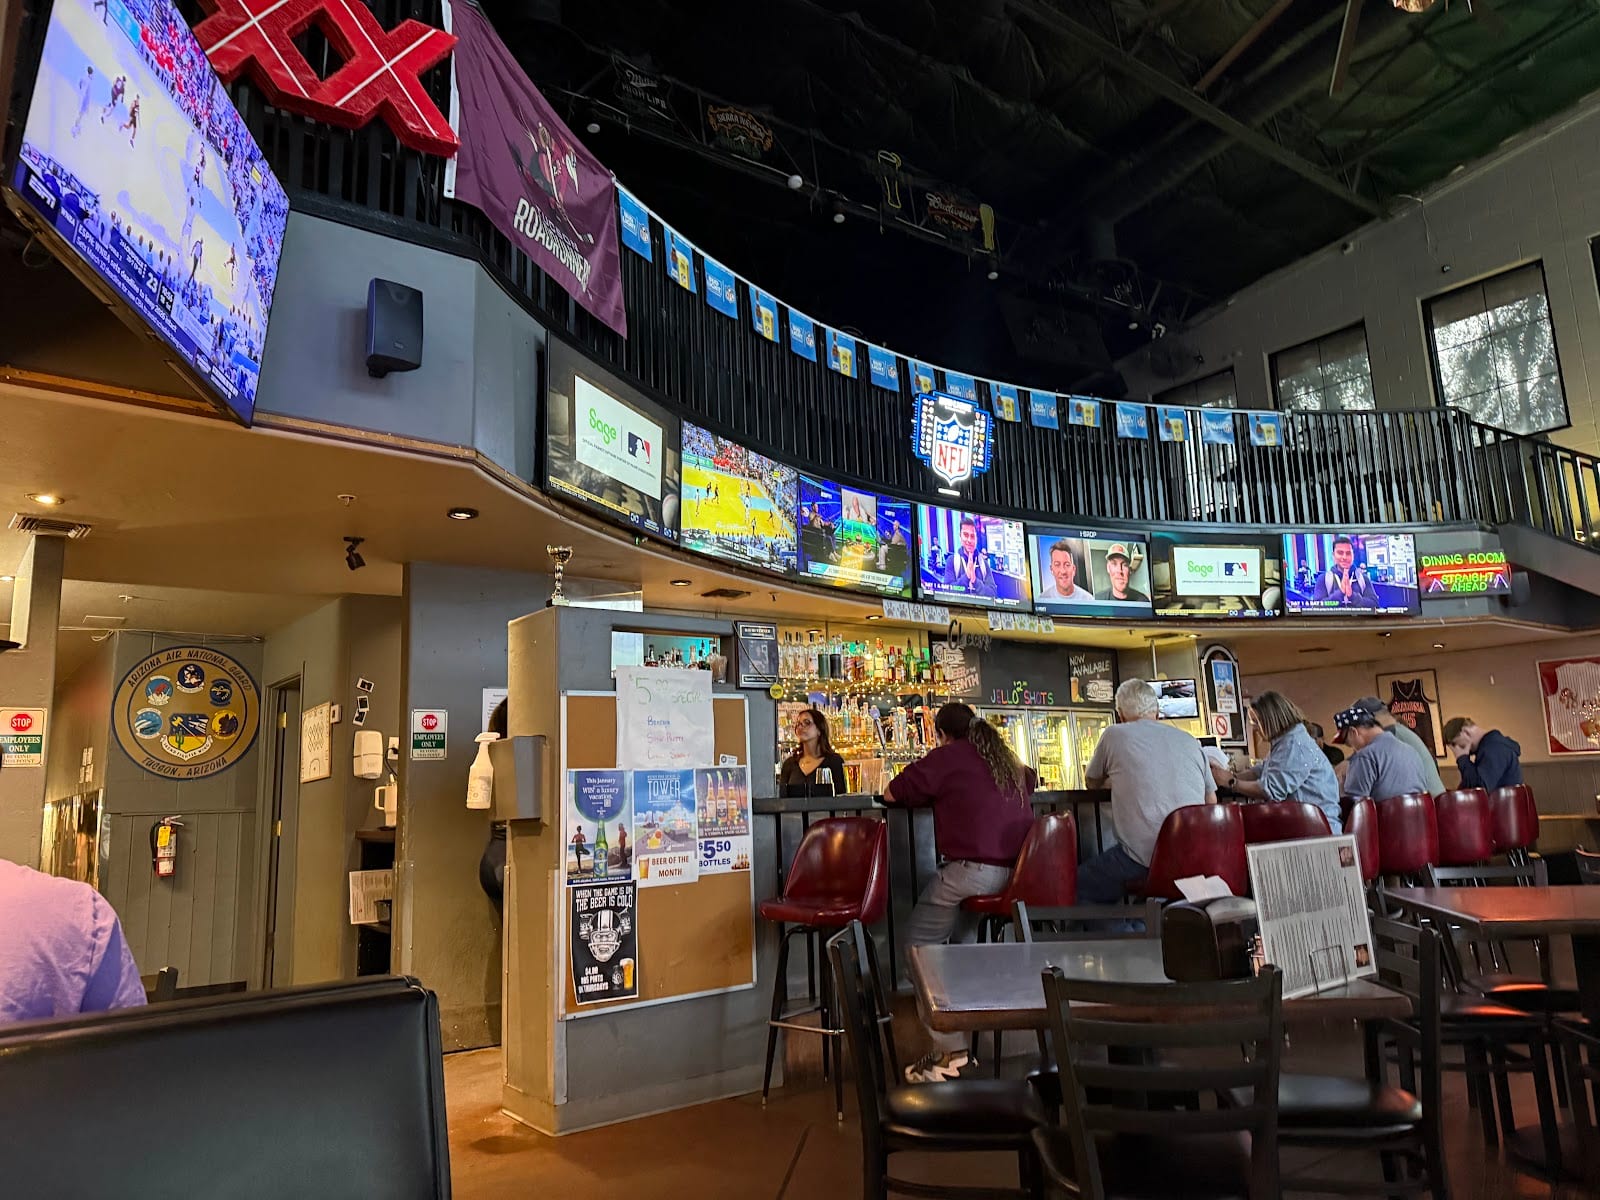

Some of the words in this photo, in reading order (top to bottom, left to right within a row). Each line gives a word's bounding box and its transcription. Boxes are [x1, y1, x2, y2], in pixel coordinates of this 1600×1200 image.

[589, 407, 617, 445] Sage
[938, 443, 965, 474] NFL
[1422, 553, 1464, 567] DINING
[1468, 552, 1505, 564] ROOM
[1187, 560, 1214, 577] Sage
[1441, 572, 1494, 584] STRAIGHT
[1451, 582, 1488, 592] AHEAD
[1070, 653, 1085, 666] NOW
[127, 657, 162, 688] ARIZONA
[166, 650, 182, 661] AIR
[187, 650, 227, 667] NATIONAL
[228, 666, 252, 691] GUARD
[1072, 660, 1110, 677] AVAILABLE
[991, 689, 1019, 705] JELLO
[1024, 690, 1054, 705] SHOTS
[12, 718, 31, 727] STOP
[422, 718, 437, 727] STOP
[0, 736, 40, 744] EMPLOYEES
[187, 757, 228, 777] ARIZONA
[648, 780, 680, 801] TOWER
[652, 857, 667, 865] BEER
[668, 856, 676, 864] OF
[699, 858, 731, 867] BOTTLES
[659, 868, 682, 877] MONTH
[576, 889, 592, 898] WHEN
[593, 888, 603, 897] THE
[604, 887, 618, 896] GAME
[619, 886, 624, 895] IS
[626, 885, 633, 894] ON
[576, 898, 588, 913] THE
[590, 896, 607, 909] BEER
[609, 896, 616, 906] IS
[617, 895, 633, 907] COLD
